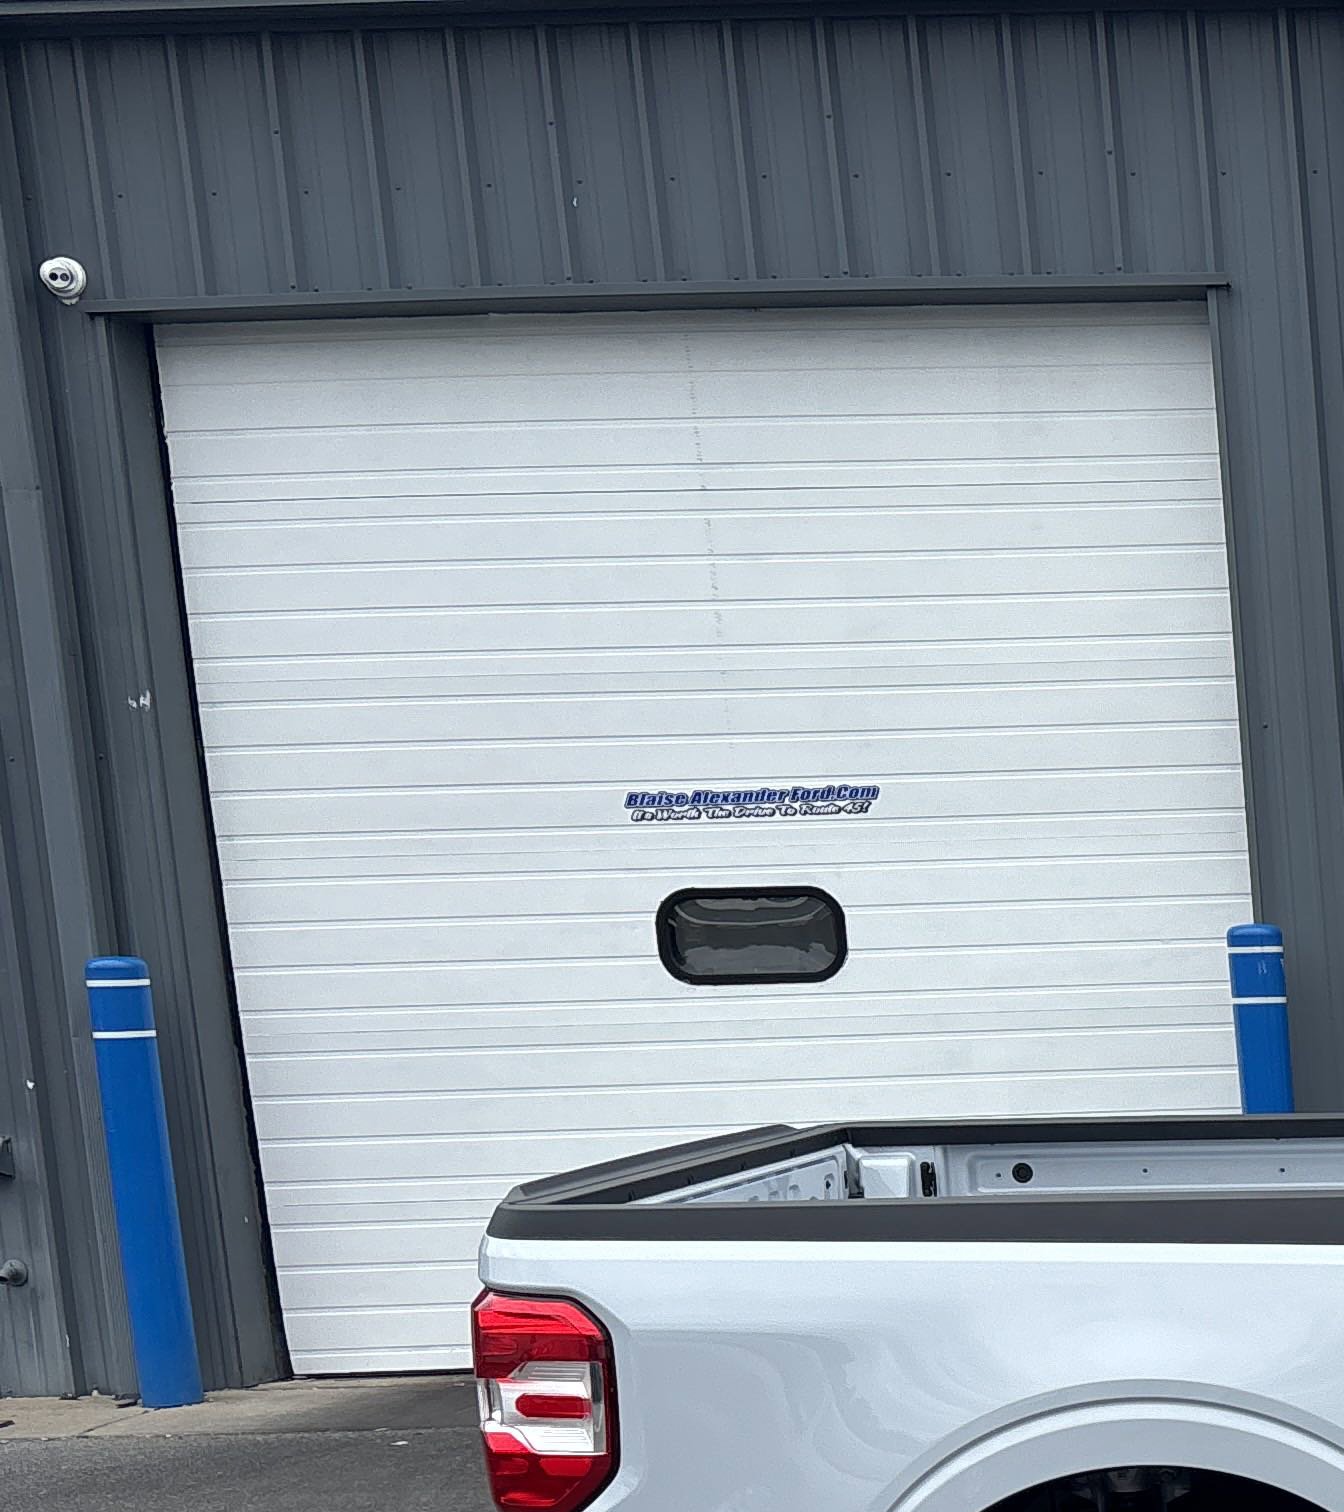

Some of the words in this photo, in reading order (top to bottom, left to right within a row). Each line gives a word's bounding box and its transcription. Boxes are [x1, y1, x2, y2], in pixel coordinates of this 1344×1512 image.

[626, 792, 688, 808] Blaise
[689, 788, 788, 805] Alexander
[703, 807, 731, 818] The
[733, 806, 775, 817] Drive
[776, 804, 798, 816] To
[799, 803, 841, 815] Route
